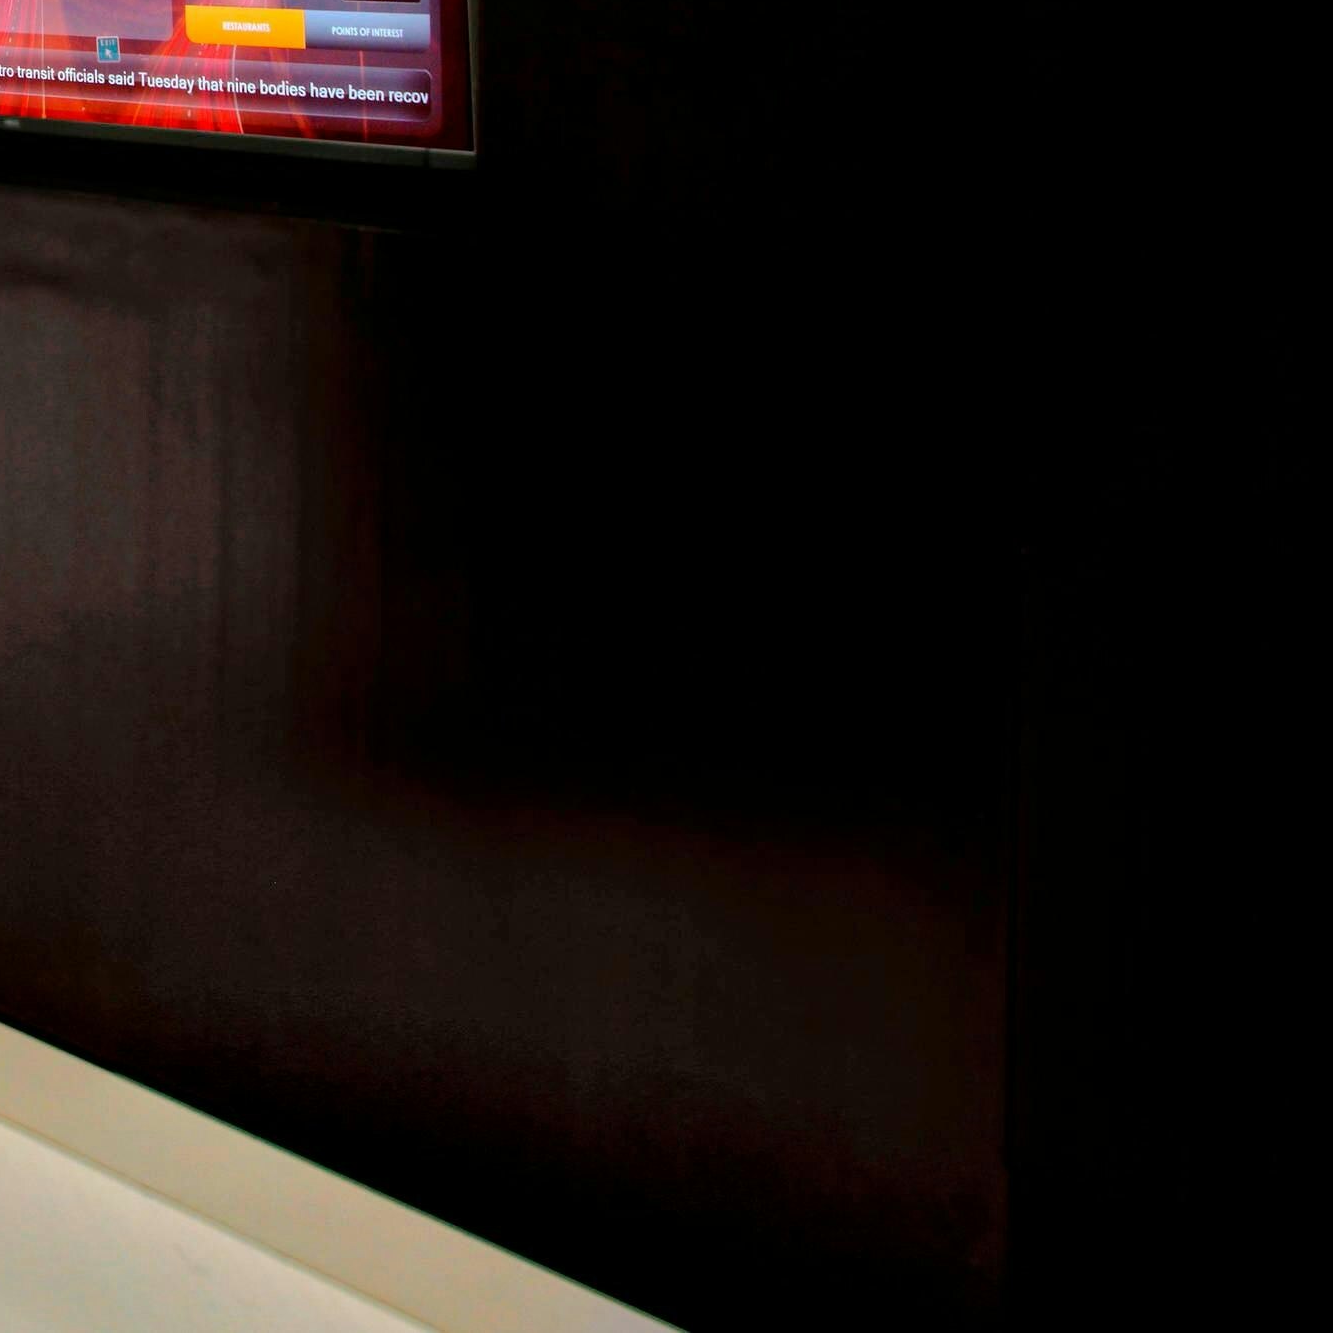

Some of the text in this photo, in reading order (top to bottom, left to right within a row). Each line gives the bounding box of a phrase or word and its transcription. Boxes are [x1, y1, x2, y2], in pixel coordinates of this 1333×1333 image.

[222, 21, 271, 32] RESTAURANTS
[332, 26, 403, 38] POINTS OF INTEREST
[17, 65, 55, 80] transit
[58, 68, 105, 83] officials
[109, 72, 134, 86] said
[139, 72, 194, 94] Tuesday
[198, 77, 224, 92] that
[227, 78, 256, 94] nine
[260, 79, 306, 96] bodies
[310, 83, 344, 99] have
[348, 86, 384, 101] been
[389, 90, 429, 104] recov
